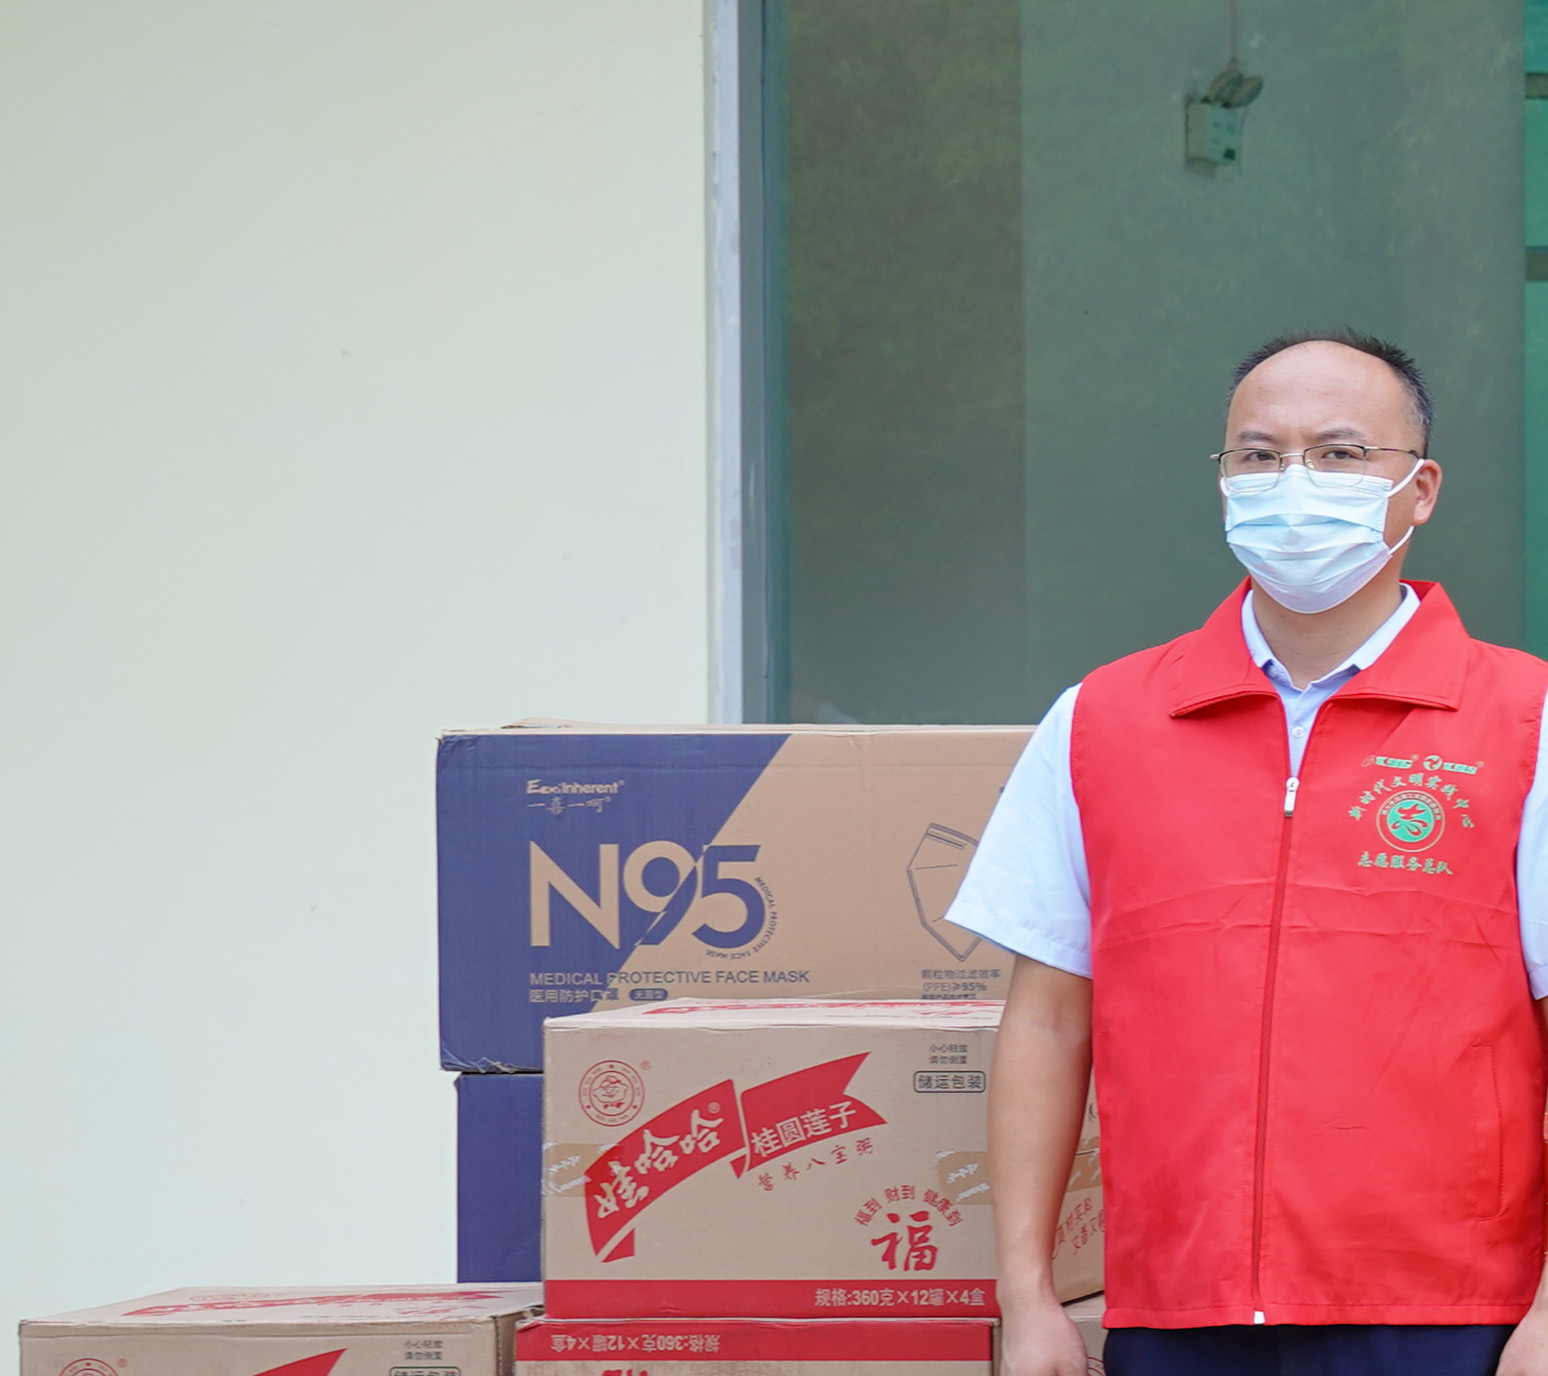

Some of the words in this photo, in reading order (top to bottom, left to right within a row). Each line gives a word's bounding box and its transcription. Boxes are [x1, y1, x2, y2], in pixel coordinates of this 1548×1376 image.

[530, 841, 765, 949] N95
[530, 972, 604, 985] MEDICAL
[607, 971, 712, 985] PROTECTIVE
[715, 970, 759, 984] FACE
[764, 970, 809, 983] MASK
[595, 1108, 724, 1219] 娃哈哈
[751, 1099, 857, 1158] 桂圆莲子
[870, 1210, 938, 1272] 福
